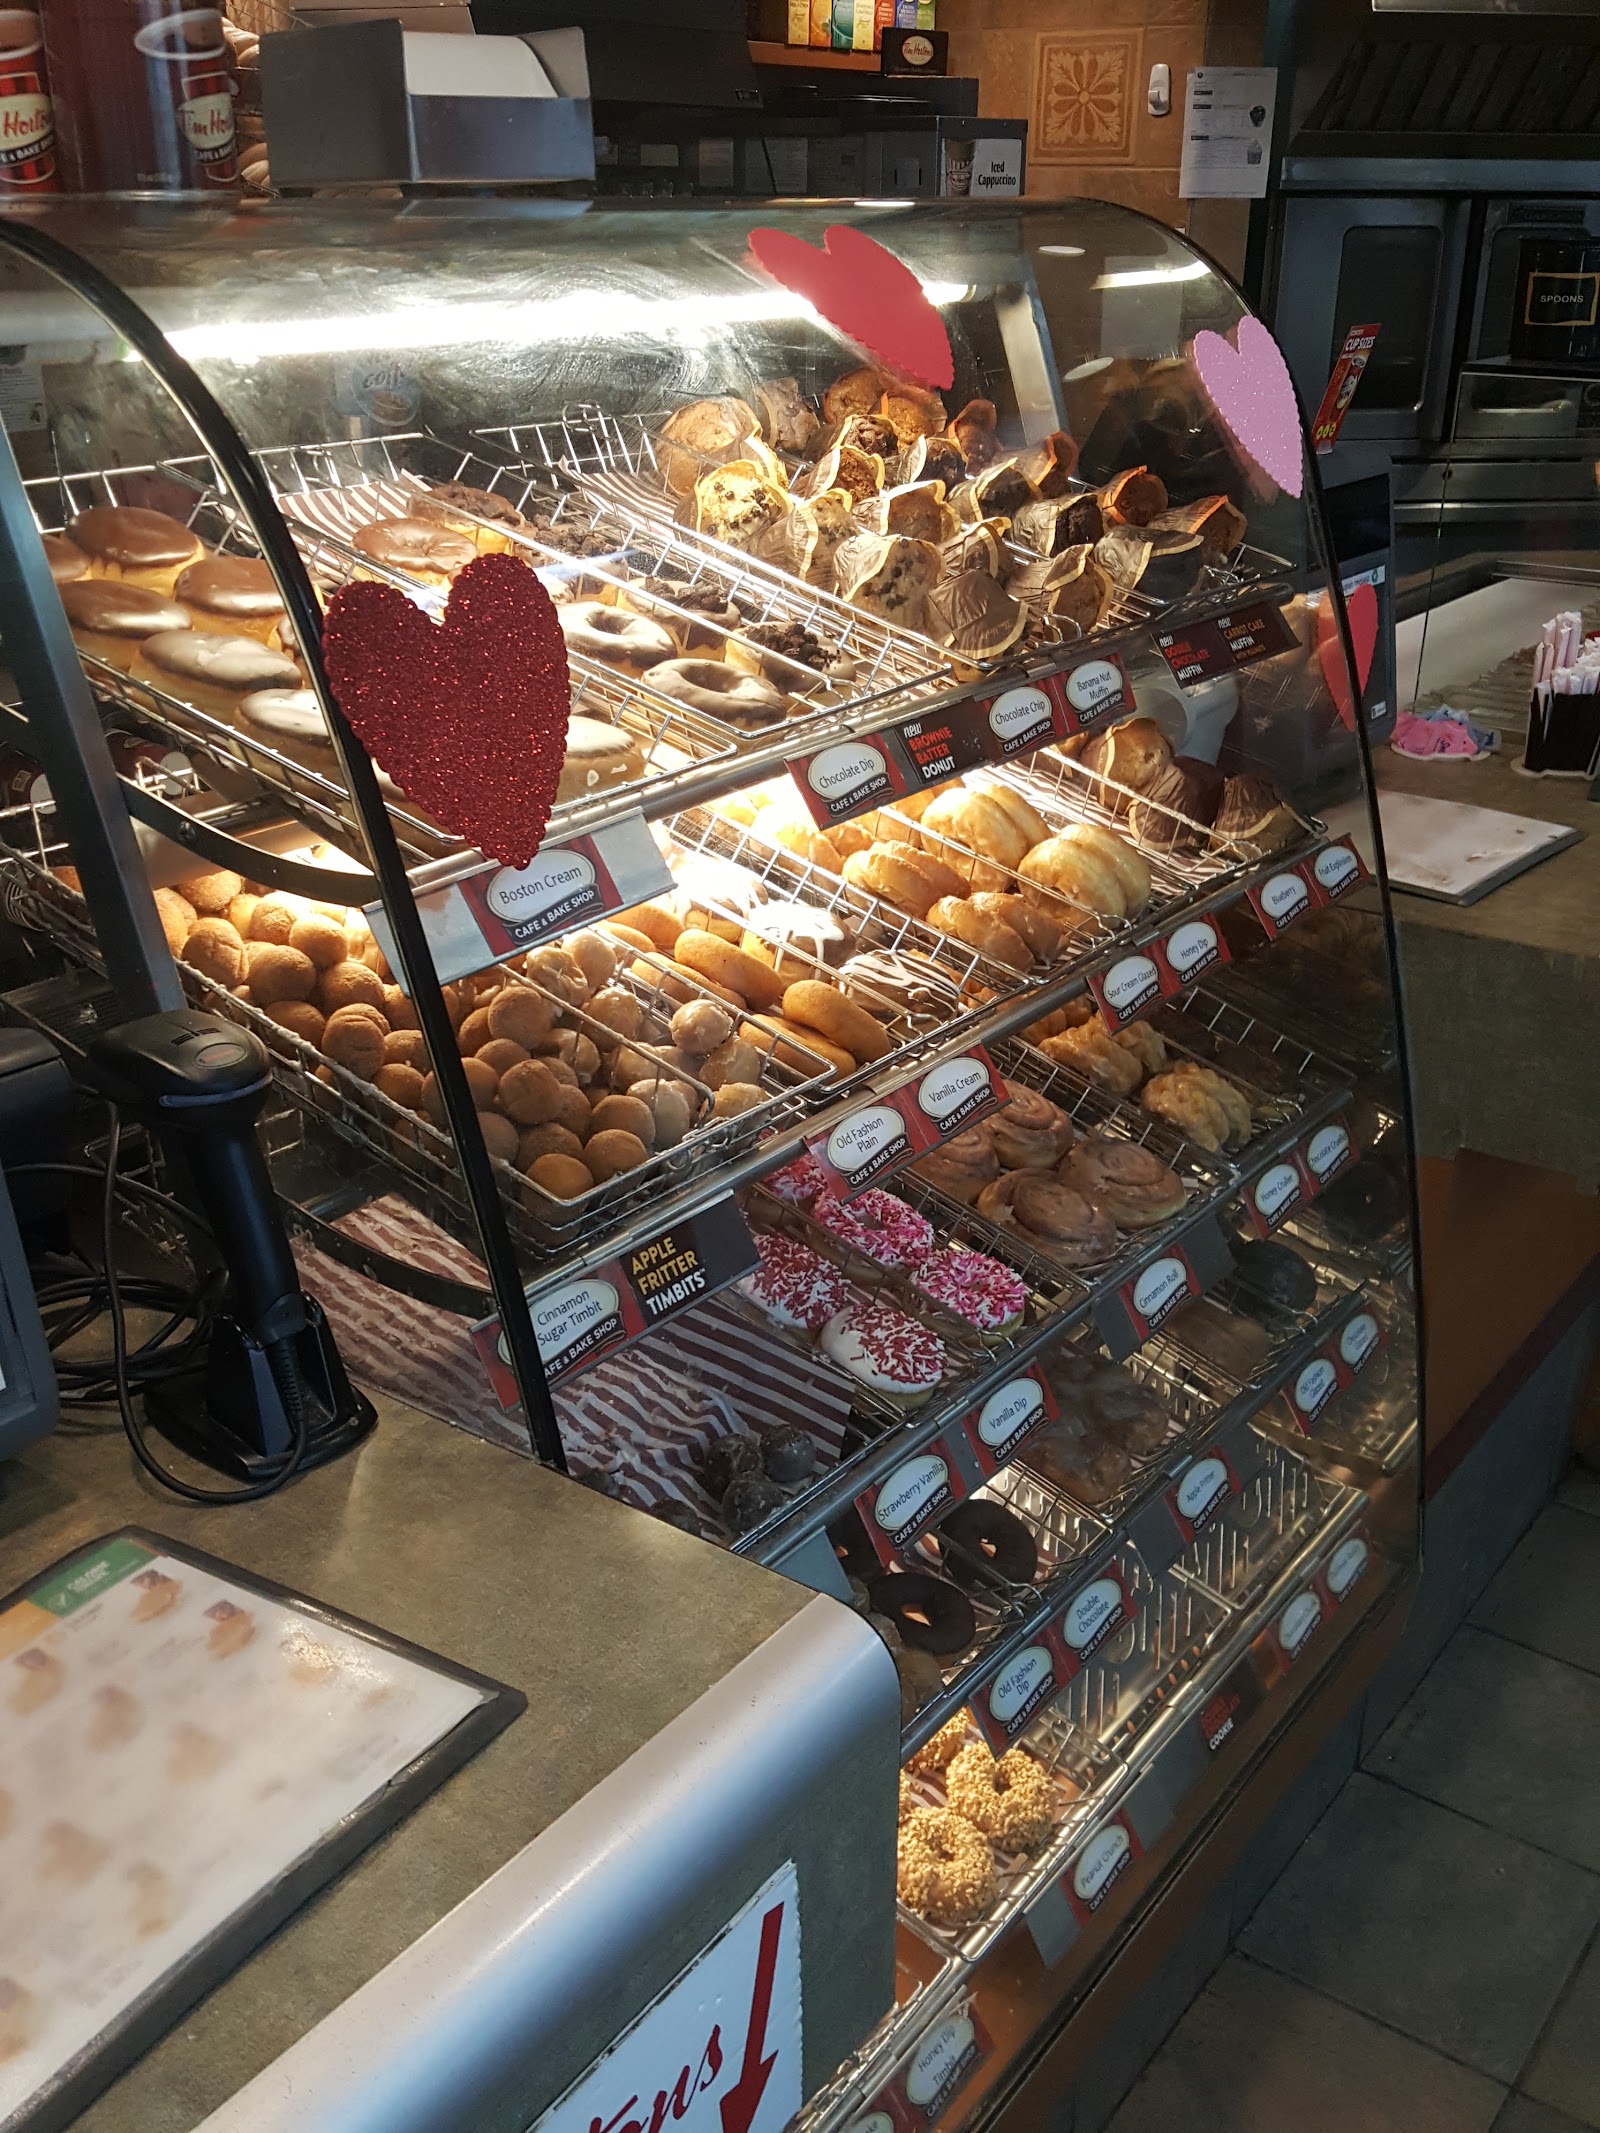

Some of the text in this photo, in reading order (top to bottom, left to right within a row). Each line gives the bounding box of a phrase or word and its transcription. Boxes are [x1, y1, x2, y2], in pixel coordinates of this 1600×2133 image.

[978, 174, 1017, 189] Cappuccino
[991, 161, 1005, 173] Iced
[1540, 295, 1584, 303] SPOONS
[1345, 336, 1376, 351] CUP SIZES
[1224, 619, 1265, 639] CARROT CAKE
[1230, 635, 1255, 651] MUFFIN
[1076, 671, 1112, 692] Banana Nut
[1177, 664, 1204, 680] MUFFIN
[1079, 711, 1094, 722] CAFE
[1096, 701, 1109, 714] BAKE
[1109, 693, 1122, 705] SHOP
[1089, 686, 1110, 701] Muffin
[995, 699, 1046, 725] Chocolate Chip
[903, 722, 922, 738] new
[908, 726, 952, 751] BROWNIE
[1004, 740, 1020, 752] CAFE
[1022, 728, 1037, 742] BAKE
[1036, 720, 1050, 733] SHOP
[915, 743, 950, 764] BATTER
[922, 756, 955, 779] DONUT
[819, 758, 875, 788] Chocolate Dip
[830, 798, 850, 811] CAFE
[852, 785, 870, 800] BAKE
[870, 777, 886, 790] SHOP
[499, 865, 583, 905] Boston Cream
[1271, 886, 1296, 905] Blueberry
[515, 924, 541, 939] CAFE
[547, 900, 572, 923] BAKE
[571, 889, 595, 908] SHOP
[1181, 938, 1208, 959] Honey Dip
[1108, 968, 1156, 999] Sour Cream Glazed
[1119, 1007, 1132, 1020] CAFE
[928, 1071, 982, 1103] Vanilla Cream
[939, 1115, 957, 1131] CAFE
[960, 1097, 977, 1116] BAKE
[975, 1087, 990, 1104] SHOP
[836, 1117, 885, 1149] Old Fashion
[856, 1134, 879, 1153] Plain
[850, 1169, 869, 1185] CAFE
[872, 1149, 890, 1168] BAKE
[889, 1138, 906, 1155] SHOP
[1260, 1174, 1293, 1202] Honey Cruller
[631, 1236, 677, 1275] APPLE
[637, 1250, 699, 1297] FRITTER
[1139, 1268, 1179, 1308] Cinnamon Roll
[537, 1289, 590, 1326] Cinnamon
[646, 1271, 706, 1316] TIMBITS
[537, 1300, 603, 1347] Sugar Timbit
[1150, 1312, 1162, 1327] CAFE
[1163, 1296, 1177, 1312] BAKE
[544, 1360, 563, 1378] AFE
[569, 1335, 594, 1358] BAKE
[594, 1318, 618, 1340] SHOP
[988, 1397, 1028, 1429] Vanilla Dip
[995, 1441, 1012, 1458] CAFE
[1014, 1421, 1030, 1441] BAKE
[1028, 1408, 1043, 1425] SHOP
[878, 1463, 945, 1521] Strawberry Vanilla
[1186, 1471, 1215, 1503] Apple Fritter
[894, 1524, 913, 1543] CAFE
[915, 1501, 933, 1523] BAKE
[932, 1487, 948, 1506] SHOP
[1076, 1594, 1100, 1620] Double
[1078, 1600, 1110, 1633] Chocolate
[1080, 1607, 1123, 1660] CAFE BAKE SHOP
[997, 1658, 1037, 1699] Old Fashion
[1016, 1679, 1030, 1696] Dip
[1007, 1714, 1023, 1733] CAFE
[1025, 1690, 1040, 1711] BAKE
[1039, 1675, 1053, 1695] SHOP
[1209, 1717, 1234, 1750] COOKIE
[1081, 1834, 1124, 1888] Peanut Crunch
[917, 2025, 956, 2072] Honey Dip
[932, 2055, 957, 2085] Timbit
